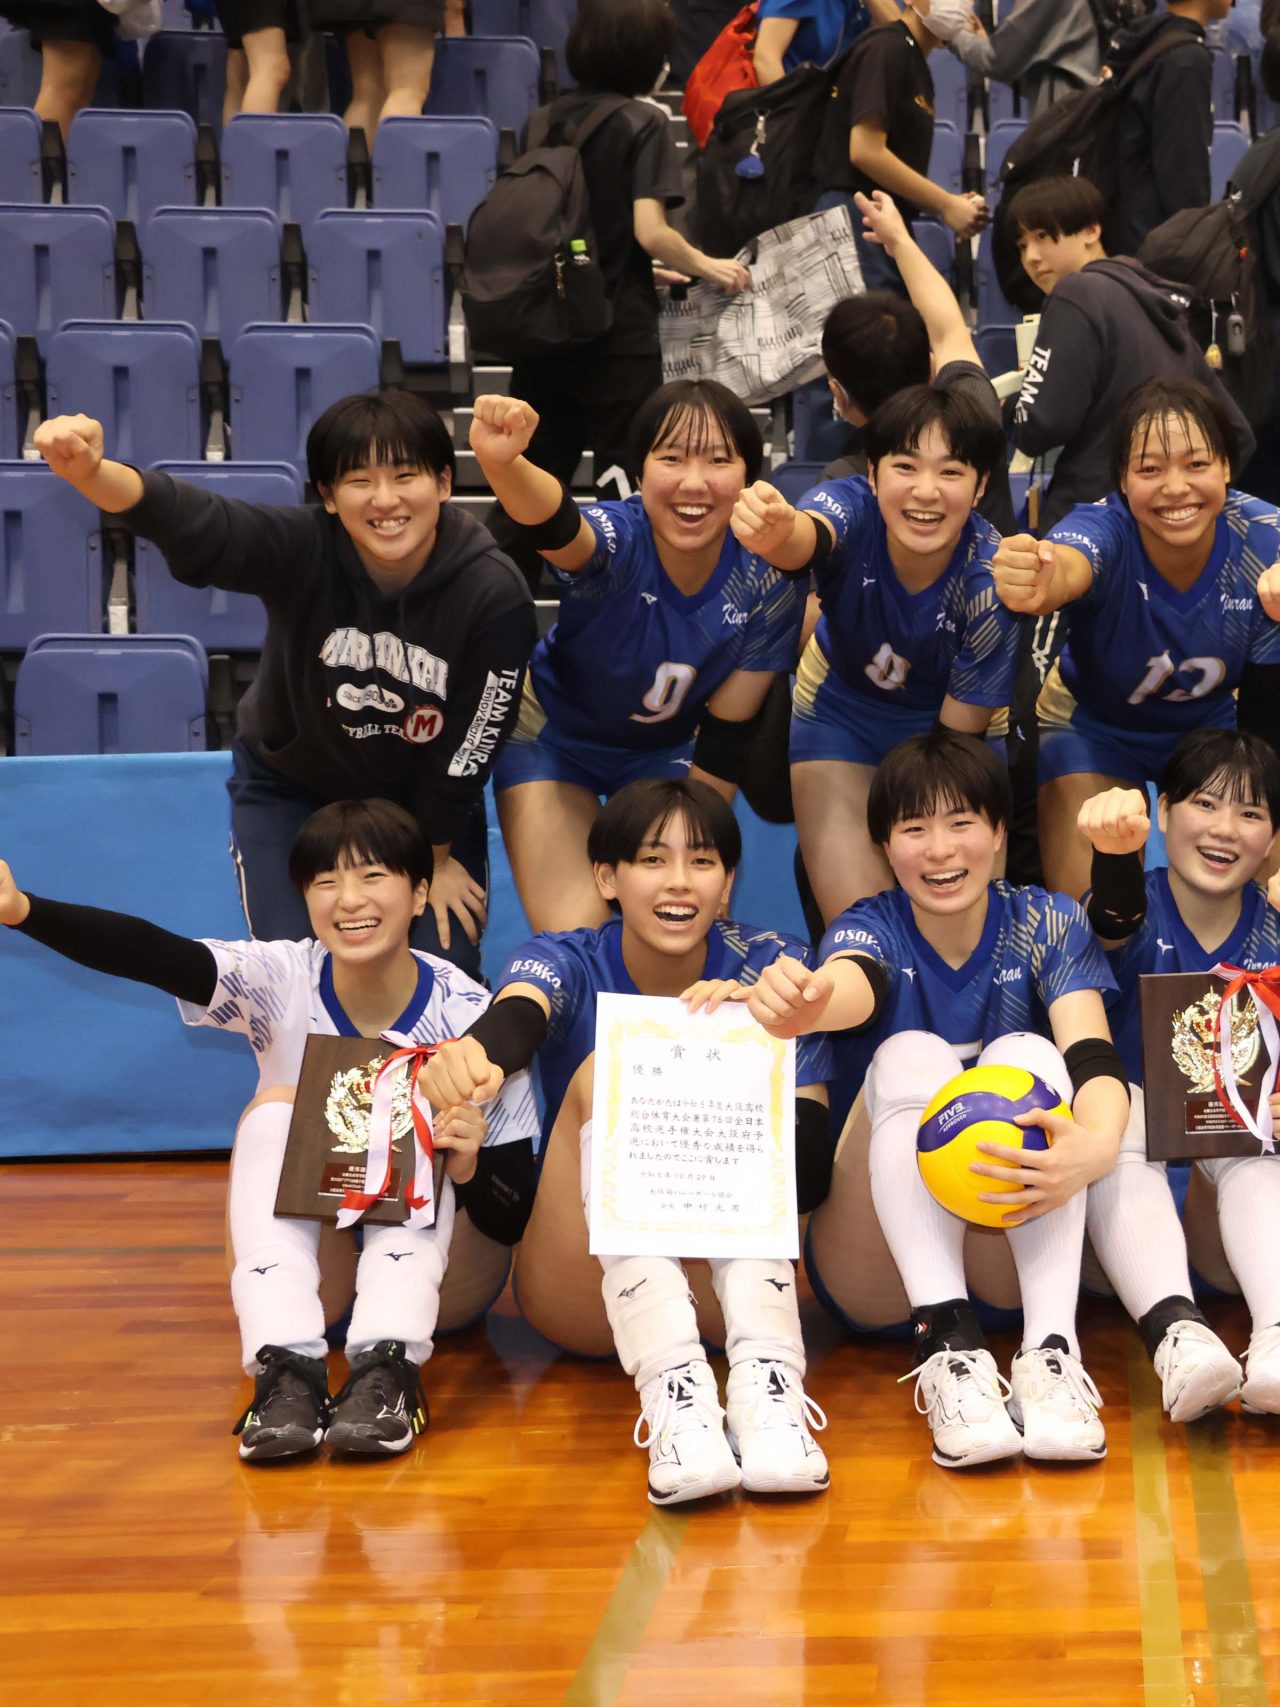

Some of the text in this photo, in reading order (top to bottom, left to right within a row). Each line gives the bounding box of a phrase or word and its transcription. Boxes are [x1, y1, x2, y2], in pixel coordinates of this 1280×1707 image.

[1017, 346, 1051, 404] TEAM
[490, 669, 519, 722] TEAM
[628, 661, 697, 724] 9
[412, 714, 437, 737] M
[671, 1044, 722, 1061] 賞状
[938, 1102, 966, 1125] FIVB
